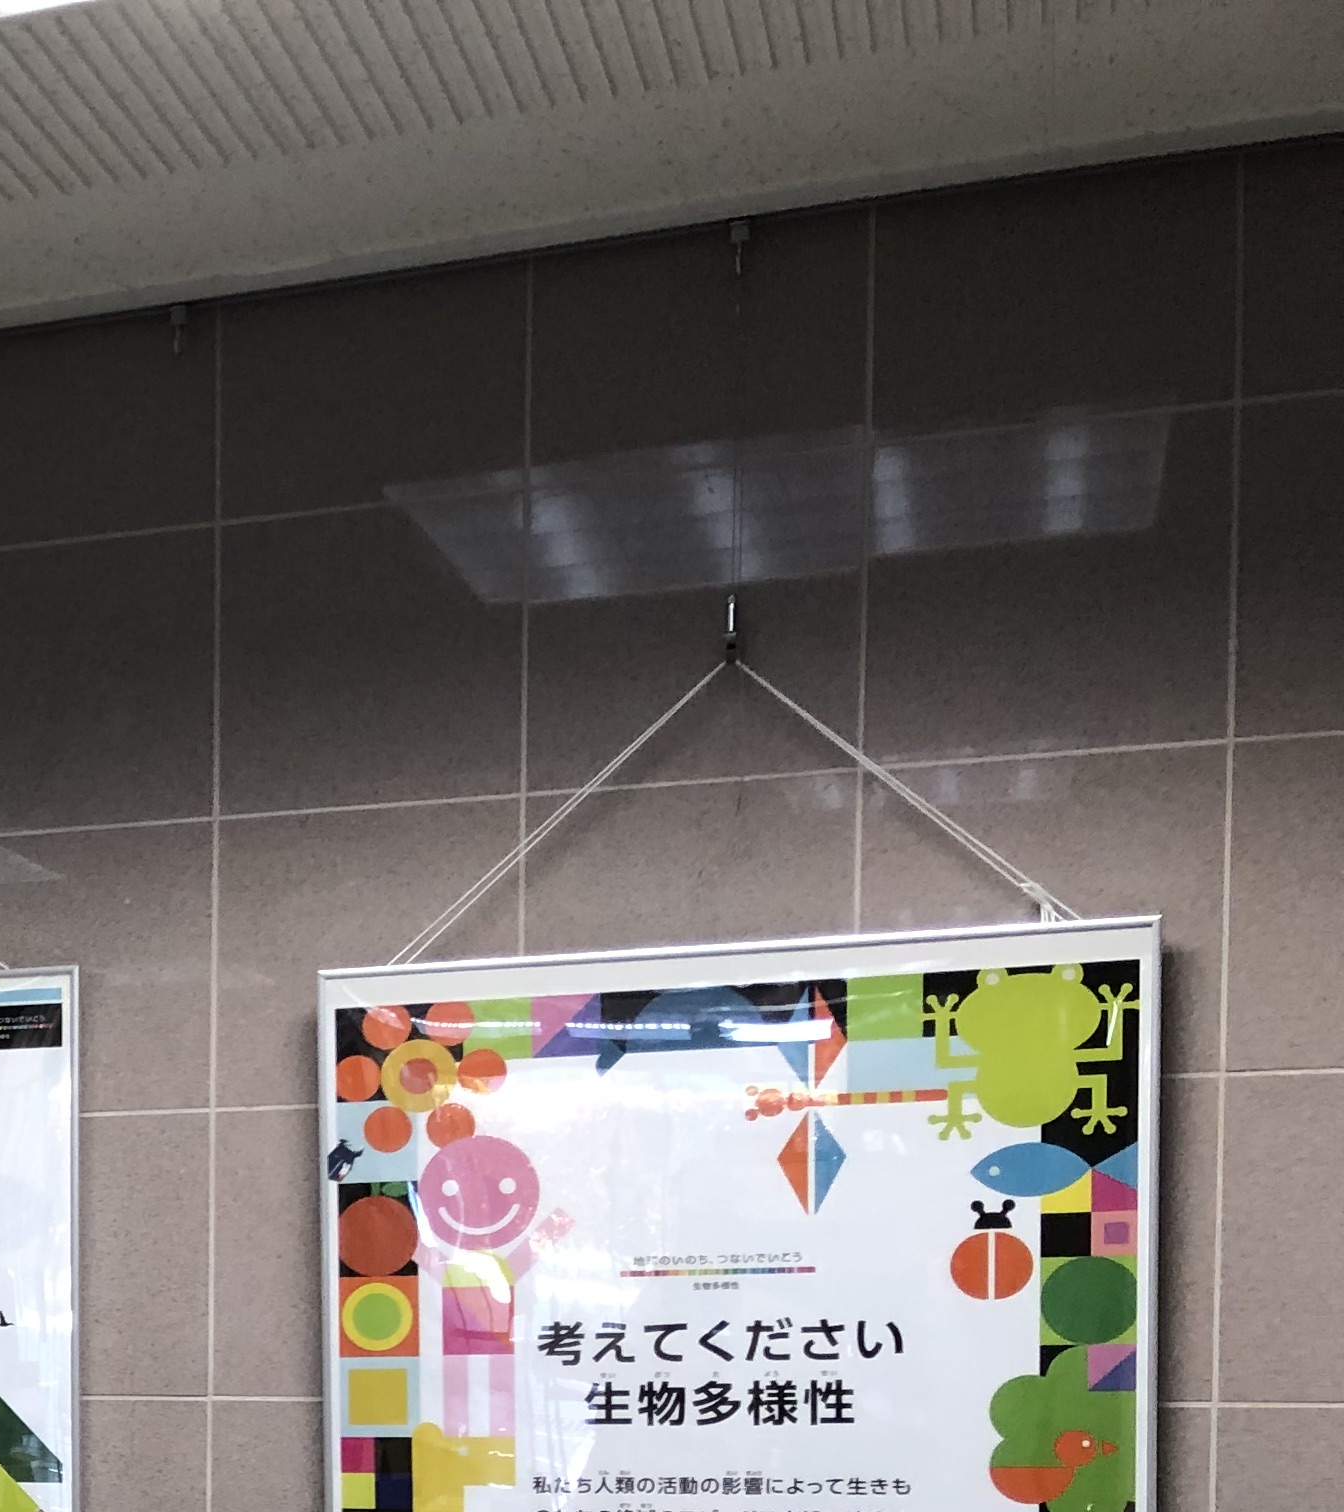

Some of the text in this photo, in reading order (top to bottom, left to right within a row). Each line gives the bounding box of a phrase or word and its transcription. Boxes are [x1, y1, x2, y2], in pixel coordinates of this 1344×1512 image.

[536, 1318, 905, 1367] 考えてください
[585, 1377, 856, 1426] 生物多様性
[533, 1476, 912, 1497] 私たち人類の活動の影響によって生きも
